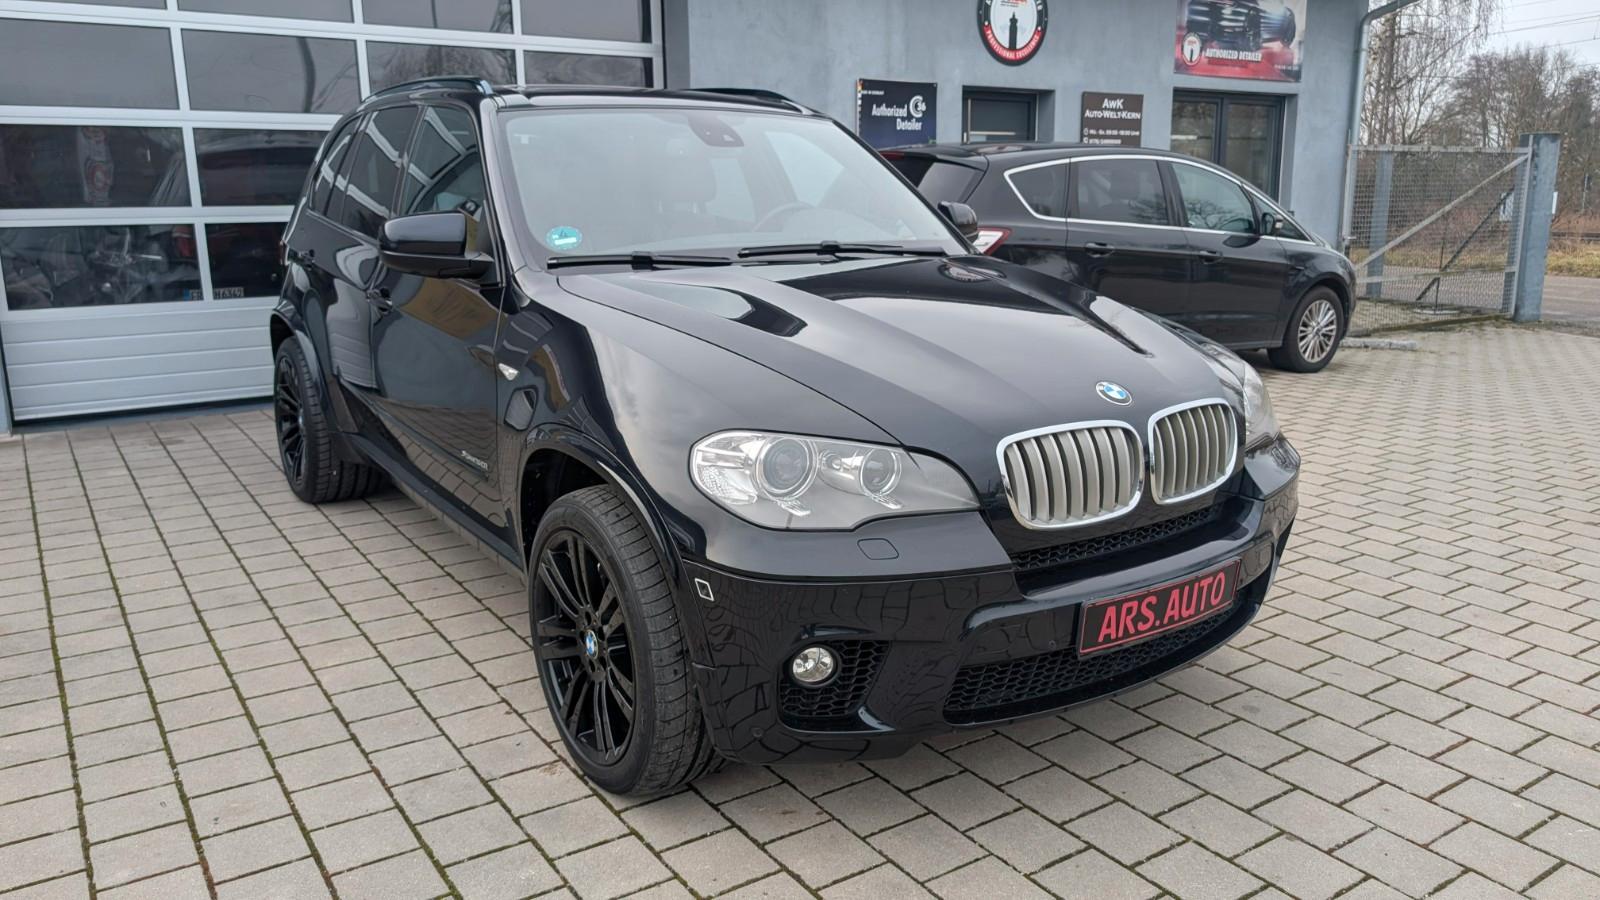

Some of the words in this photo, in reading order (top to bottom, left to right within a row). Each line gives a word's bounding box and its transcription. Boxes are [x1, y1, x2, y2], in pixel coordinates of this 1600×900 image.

[1205, 48, 1238, 60] AUTHORIZED
[1238, 51, 1262, 62] DETAILER
[871, 103, 908, 117] Authorized
[896, 118, 922, 130] Detailer
[1097, 571, 1226, 643] ARS.AUTO
